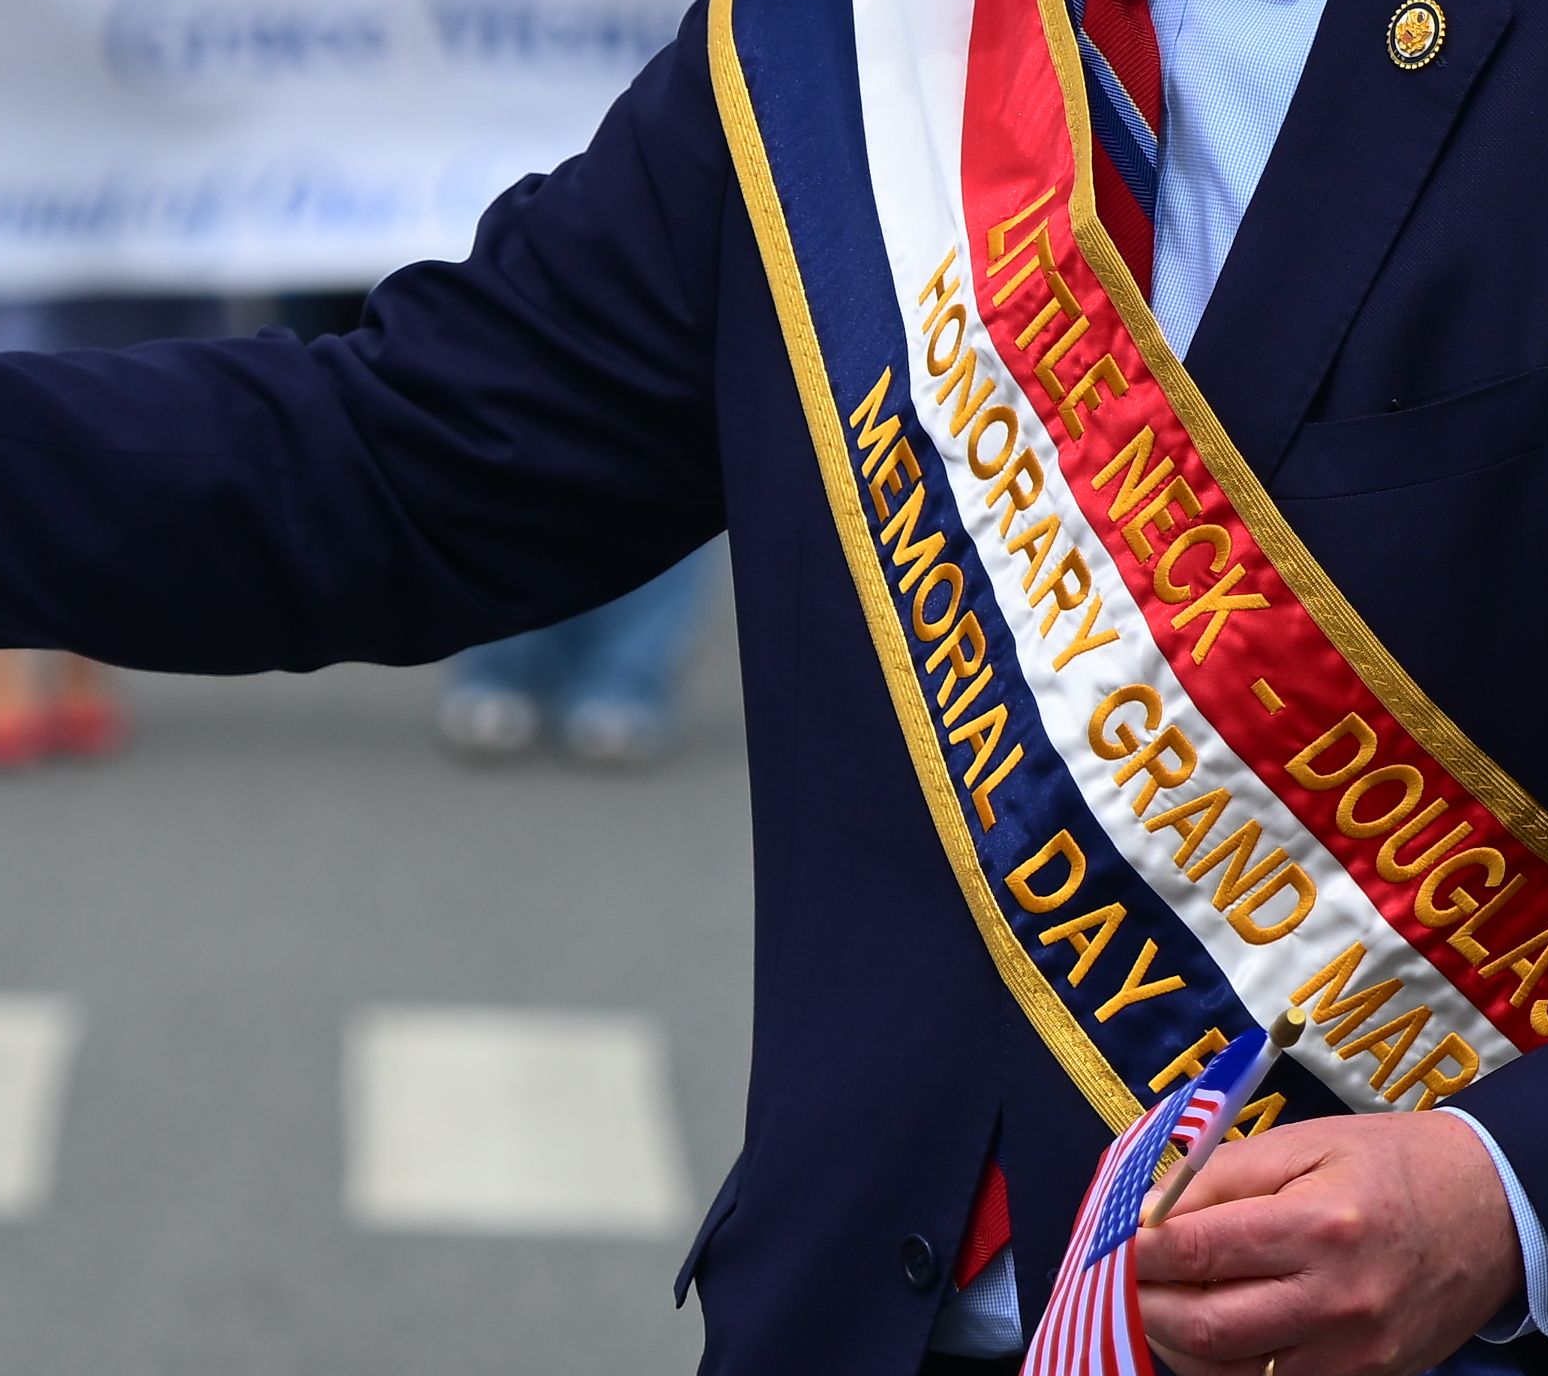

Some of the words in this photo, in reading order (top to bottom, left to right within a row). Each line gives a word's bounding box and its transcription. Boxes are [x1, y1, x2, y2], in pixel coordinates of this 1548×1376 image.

[848, 365, 1024, 833] MEMORIAL
[1004, 829, 1187, 1023] DAY
[918, 248, 1122, 672] HONORARY
[1087, 685, 1318, 945] GRAND
[1289, 941, 1481, 1112] MAR
[985, 185, 1128, 441] LITTLE
[1091, 426, 1271, 665] NECK
